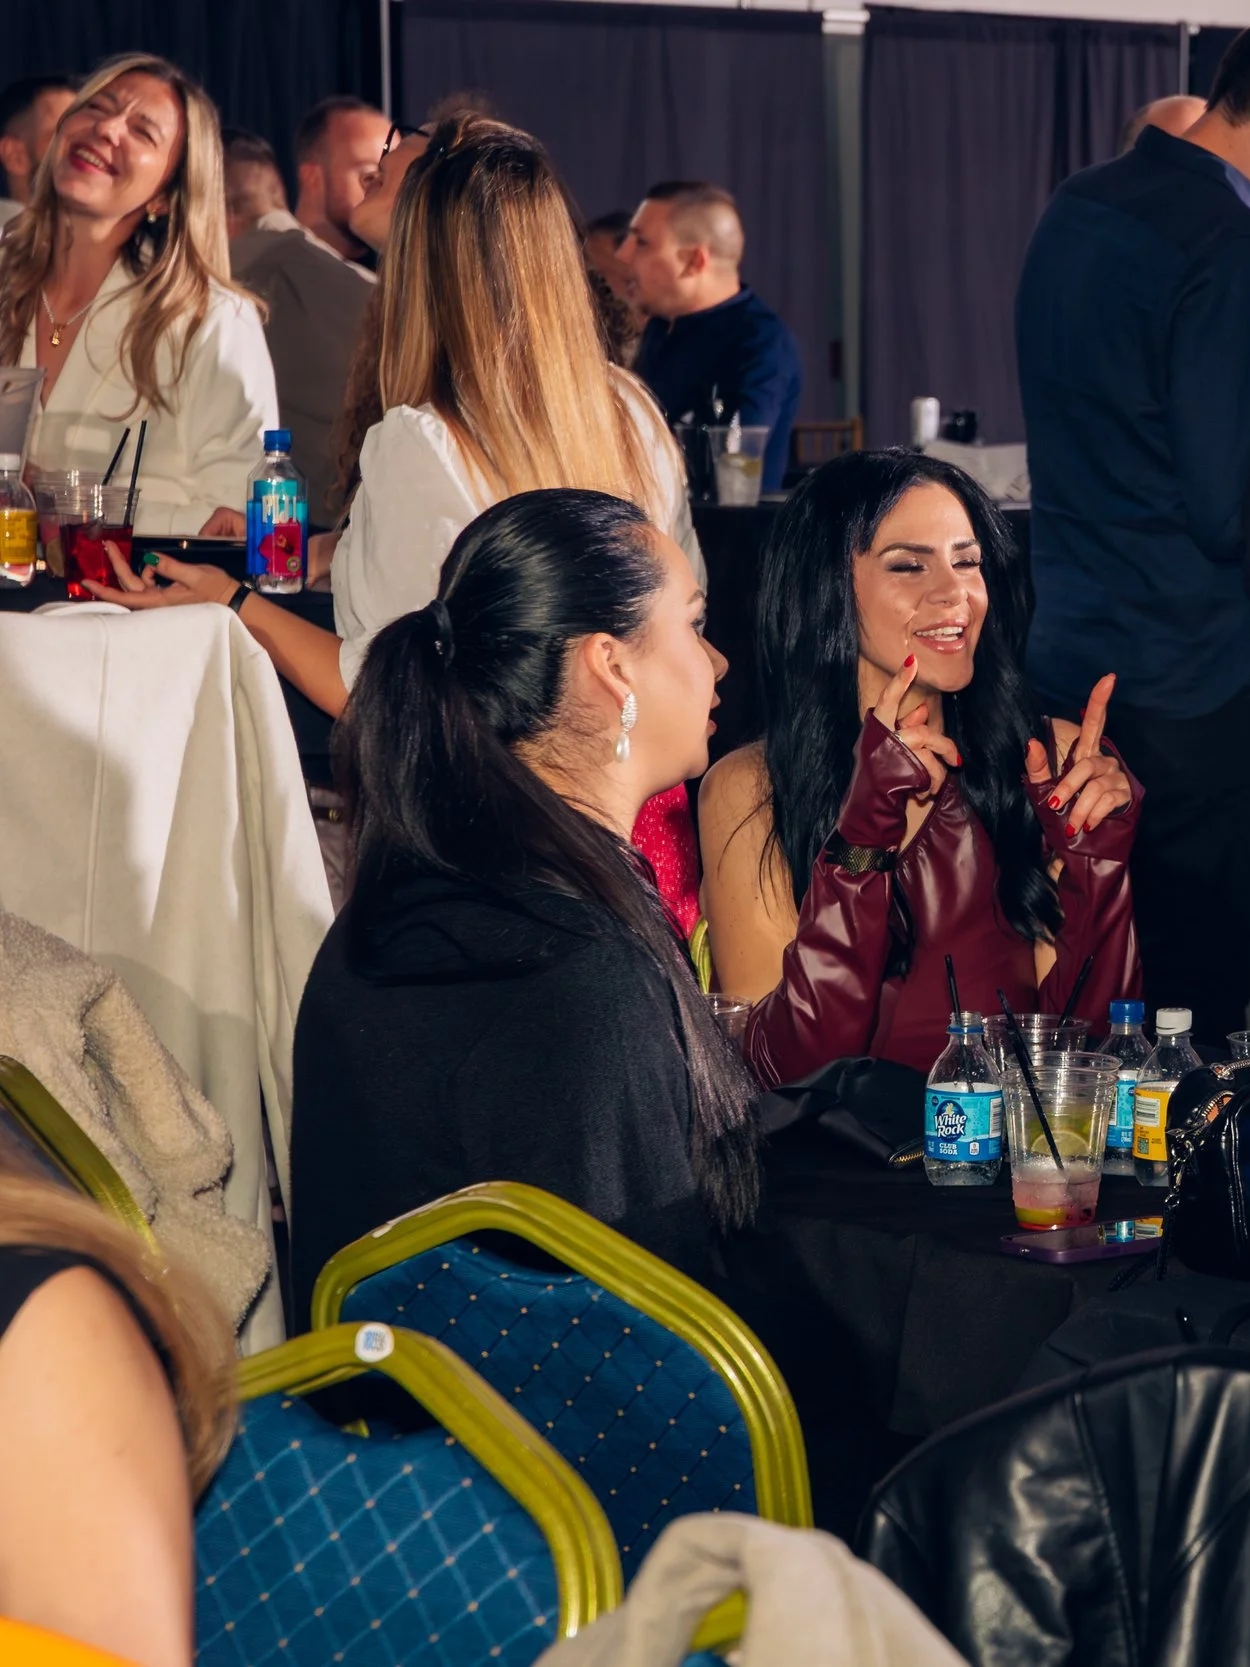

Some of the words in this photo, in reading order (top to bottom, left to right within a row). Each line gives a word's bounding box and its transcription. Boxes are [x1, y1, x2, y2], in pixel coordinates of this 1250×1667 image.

[934, 1114, 966, 1129] White
[937, 1125, 965, 1138] Rock
[939, 1148, 958, 1156] SODA
